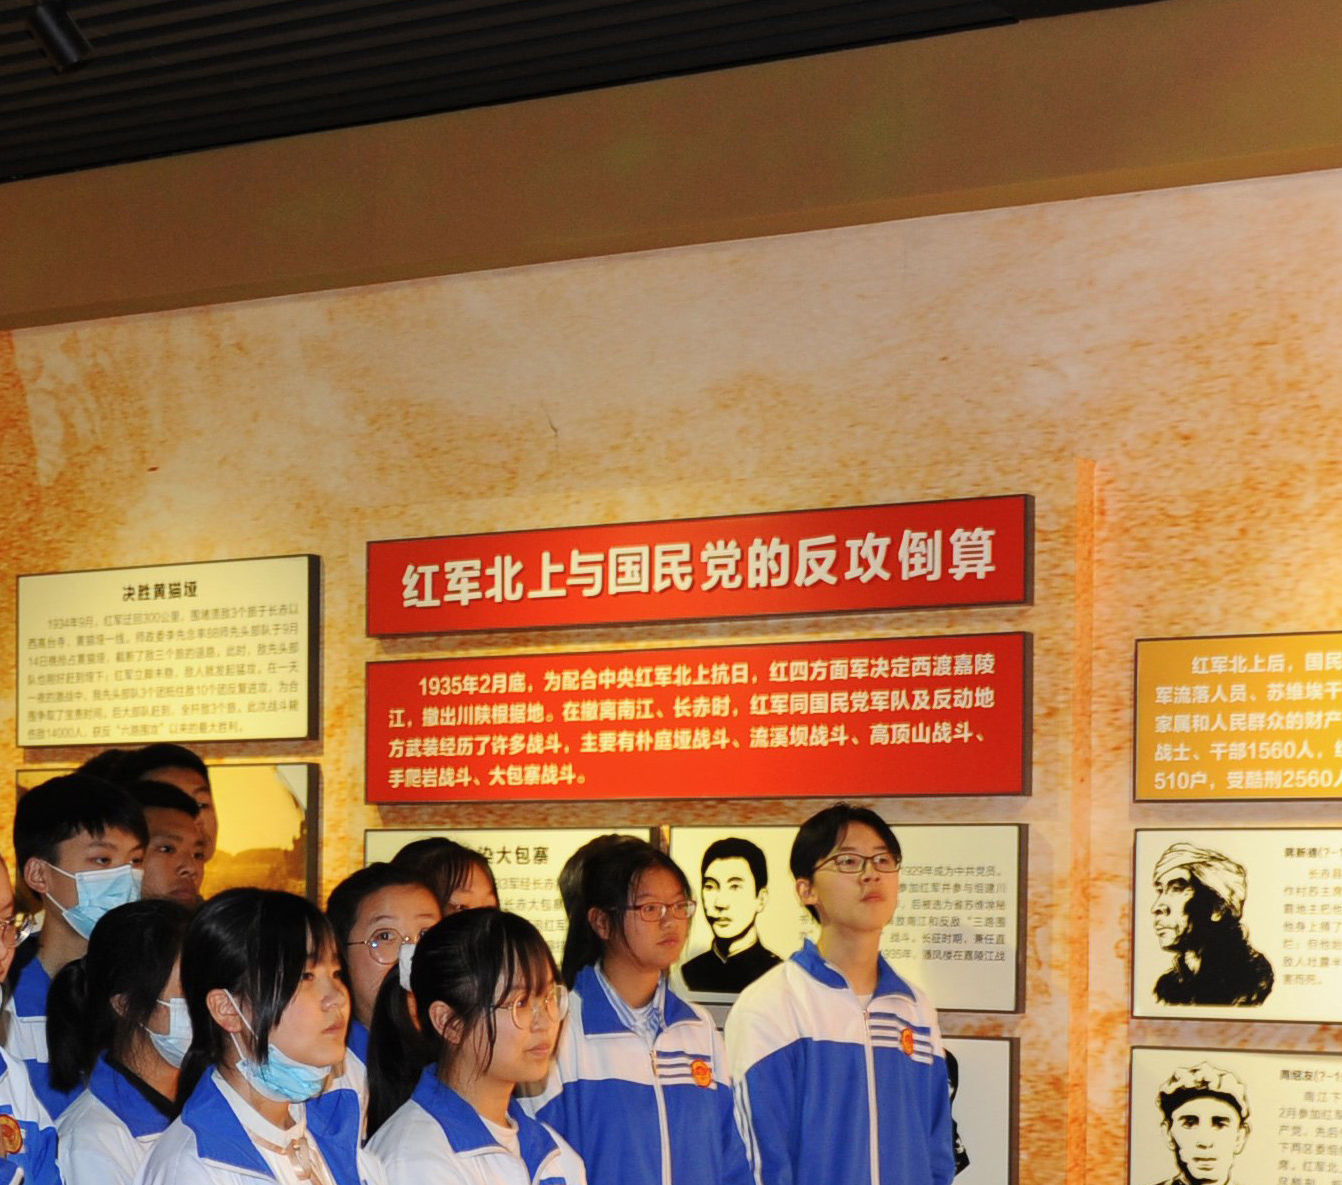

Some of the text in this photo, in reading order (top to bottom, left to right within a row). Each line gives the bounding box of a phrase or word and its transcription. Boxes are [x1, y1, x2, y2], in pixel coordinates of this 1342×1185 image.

[401, 526, 997, 609] 红军北上与国民党的反攻倒算
[418, 653, 996, 697] 1935年2月底，为配合中央红军北上抗日，红四方面军决定西渡嘉陵
[388, 687, 995, 729] 江，撤出川陕根据地。在撤离南江、长赤时，红军同国民党军队及反动地
